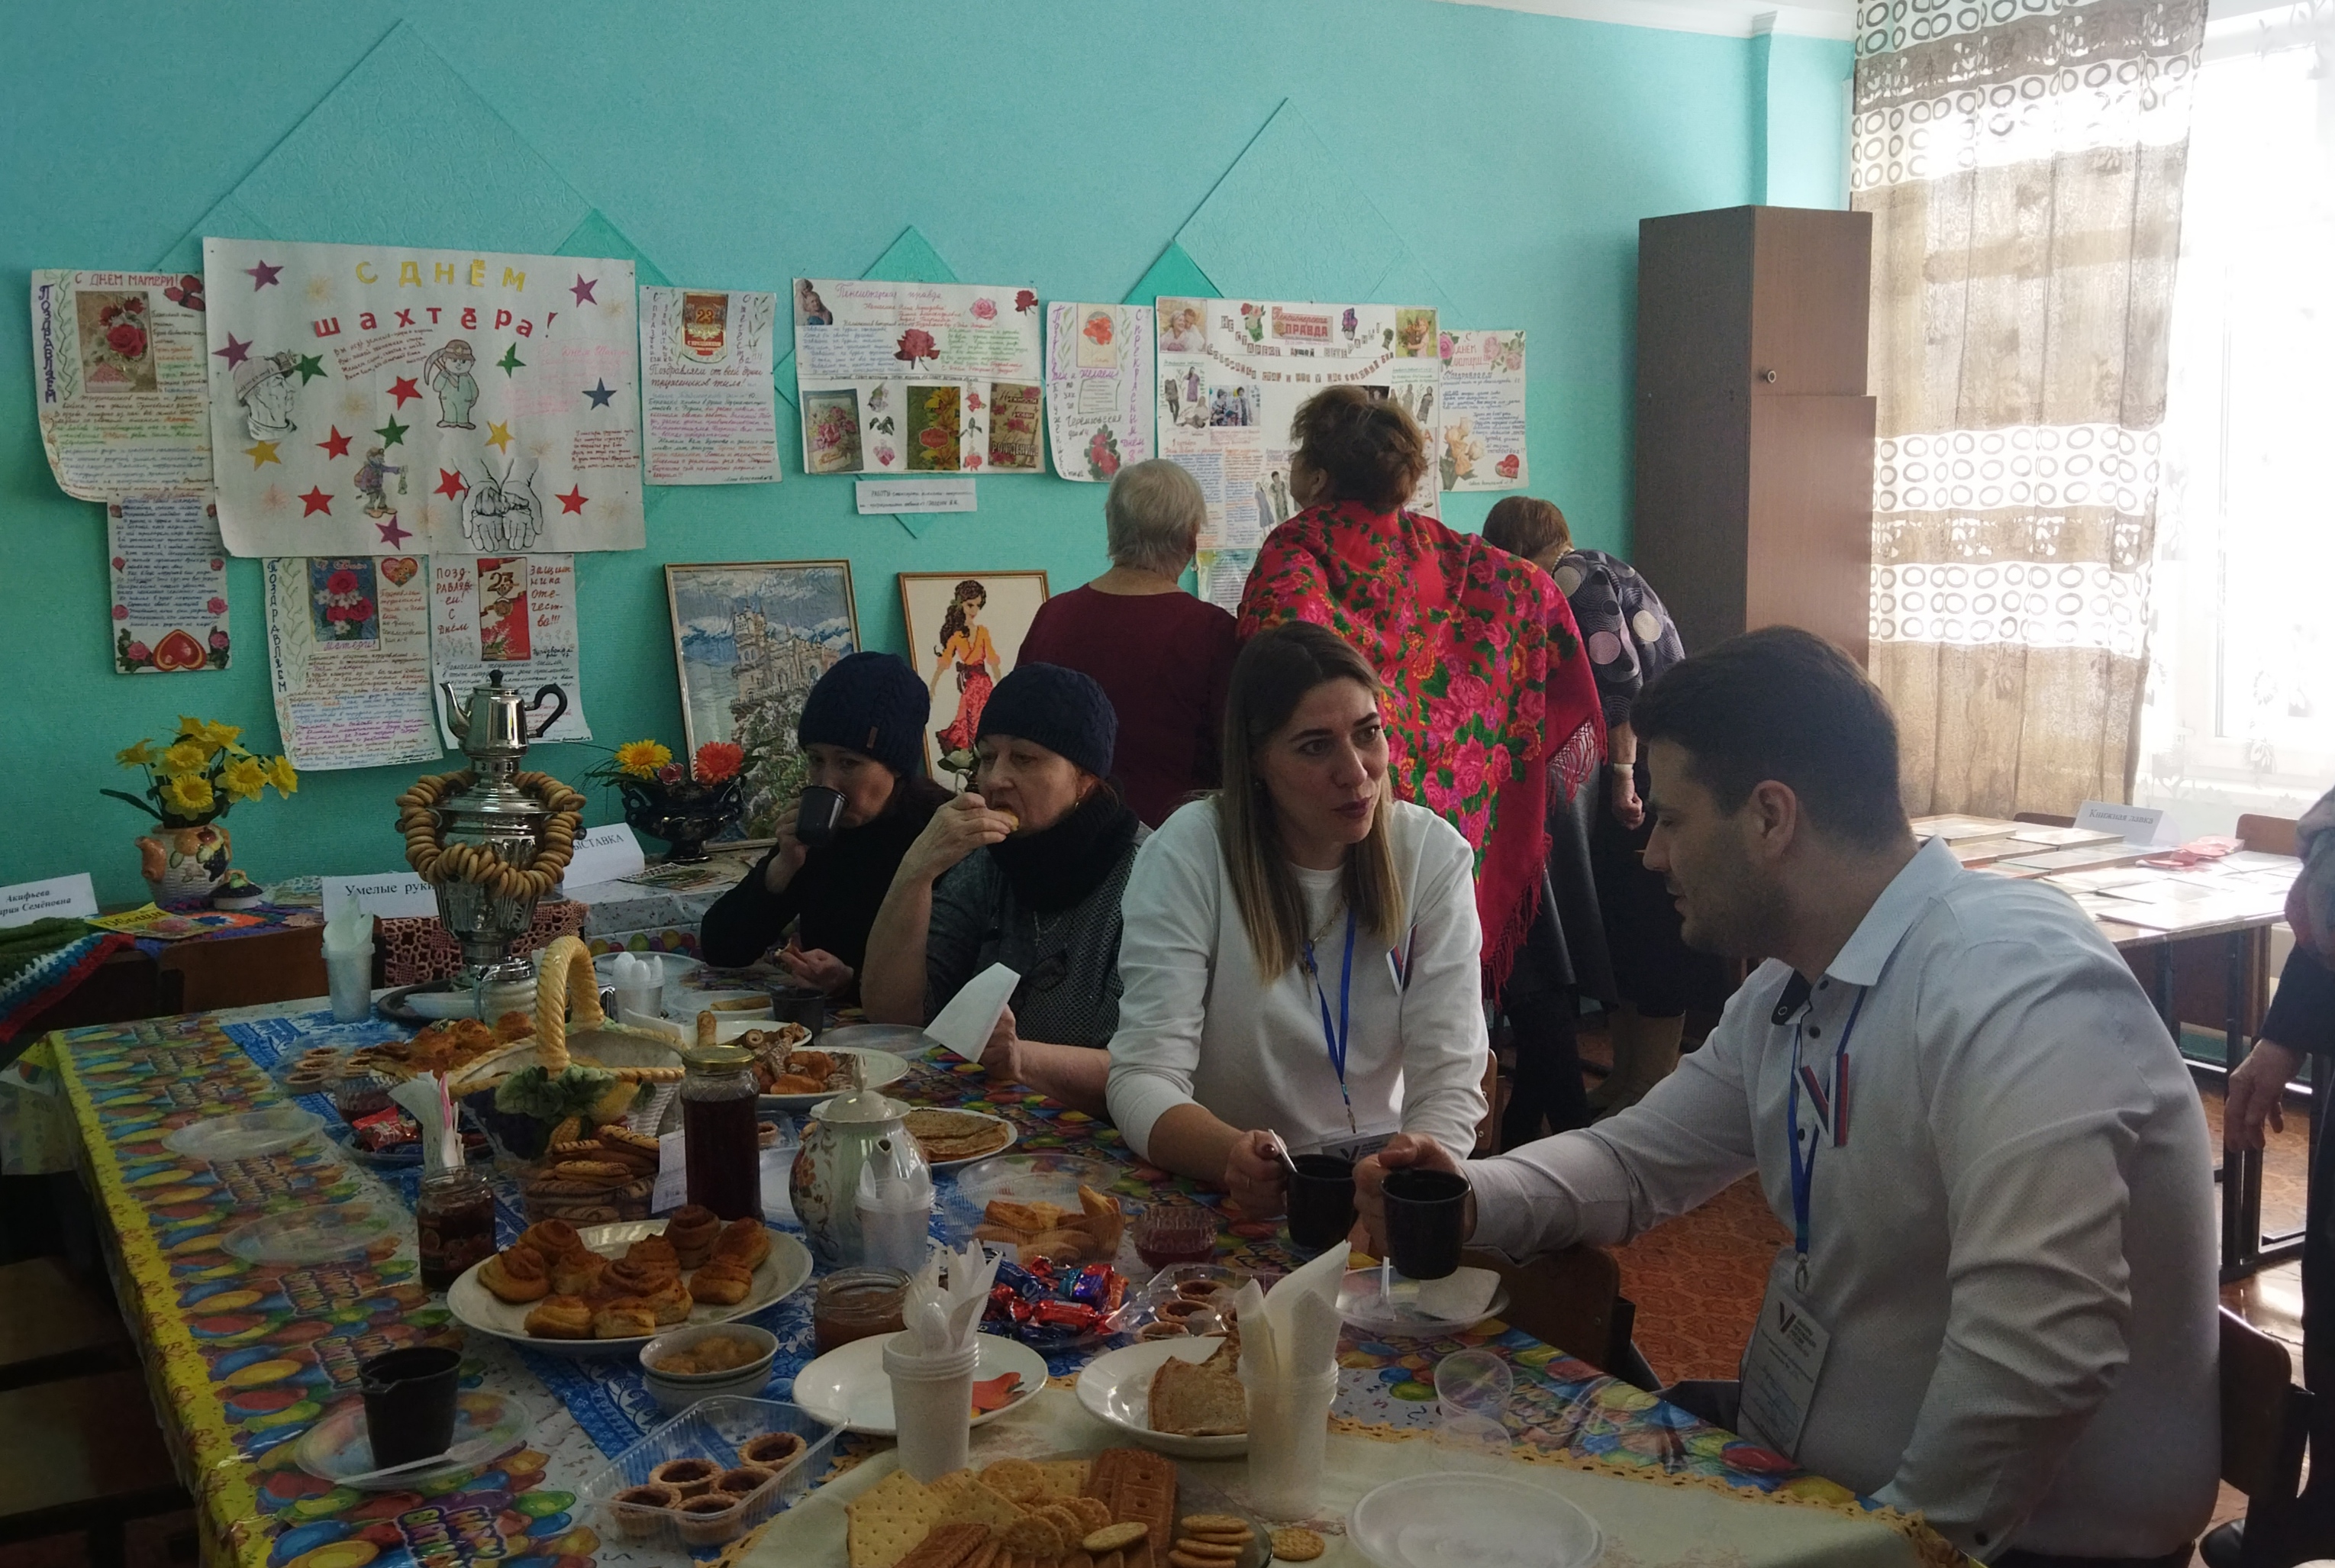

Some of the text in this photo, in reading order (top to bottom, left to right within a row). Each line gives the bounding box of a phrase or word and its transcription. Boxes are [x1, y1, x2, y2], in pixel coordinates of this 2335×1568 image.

[75, 272, 83, 285] С
[355, 259, 527, 292] С ДНЁМ
[697, 308, 714, 324] 23
[1272, 306, 1329, 326] Пенсионерская
[1285, 324, 1329, 337] ПРАВДА
[447, 608, 456, 620] С
[2088, 809, 2154, 824] Книжная лавка
[572, 834, 624, 850] ЫСТАВКА
[6, 890, 50, 904] Акифьева
[345, 882, 398, 898] Умелые
[21, 897, 72, 912] Семёновна
